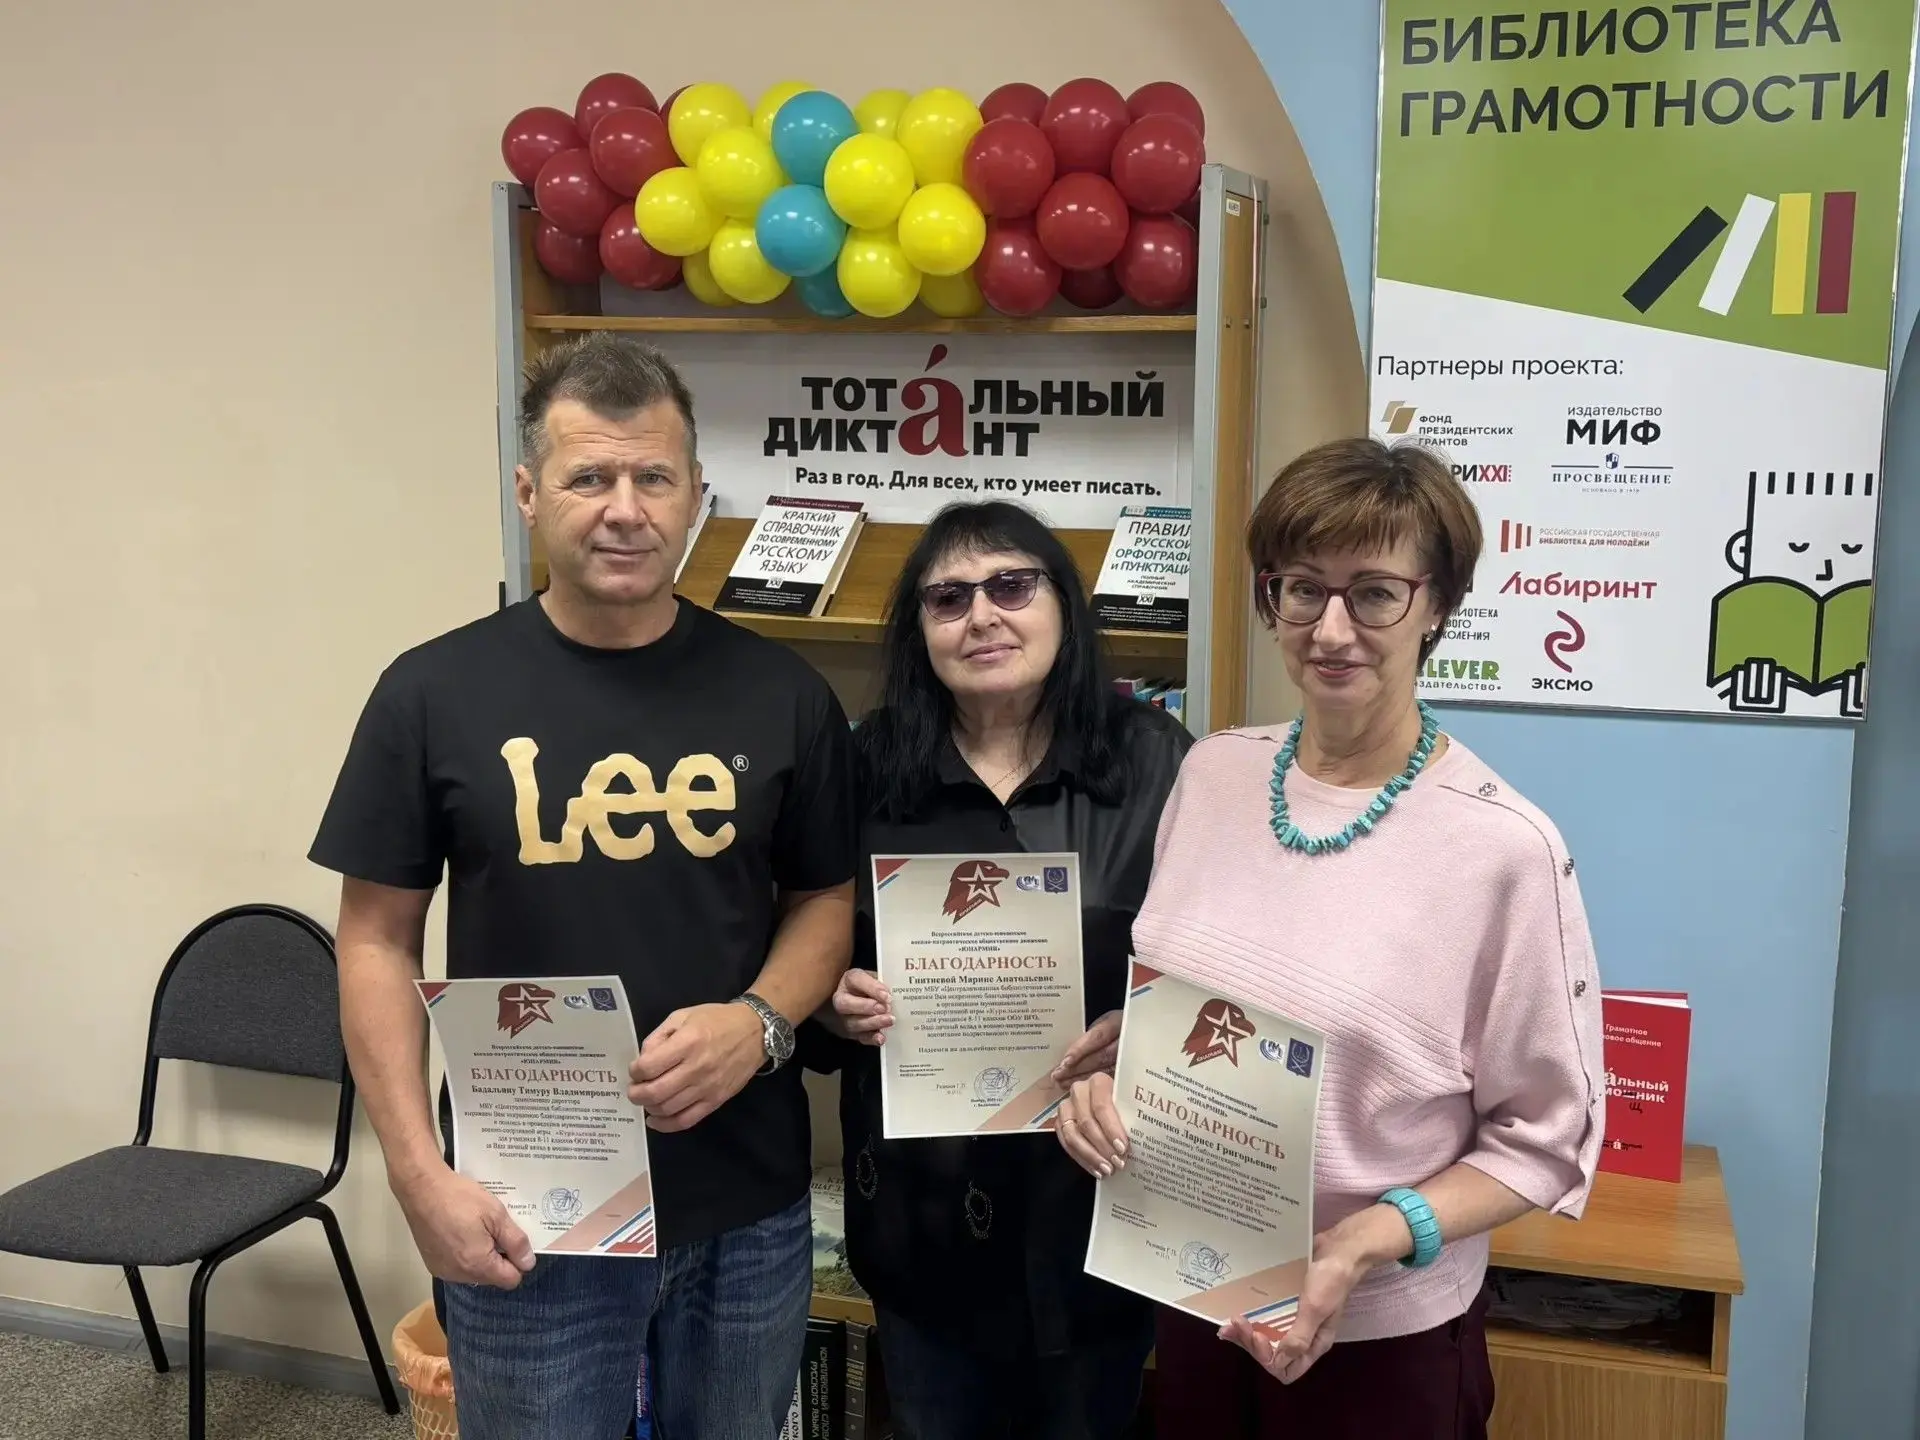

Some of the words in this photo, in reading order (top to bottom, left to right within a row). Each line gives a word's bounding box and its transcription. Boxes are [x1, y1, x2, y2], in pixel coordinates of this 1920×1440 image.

[1402, 0, 1842, 65] БИБЛИОТЕКА
[1400, 70, 1889, 137] ГРАМОТНОСТИ
[1377, 356, 1503, 380] Партнеры
[1512, 358, 1624, 380] проекта:
[1419, 415, 1452, 424] ФОНД
[1567, 406, 1662, 417] издательство
[1418, 427, 1513, 436] ПРЕЗИДЕНТСКИХ
[1566, 419, 1661, 446] МИФ
[1418, 438, 1468, 447] ГРАНТОВ
[796, 466, 828, 485] Раз
[832, 473, 843, 485] в
[847, 473, 885, 489] год.
[889, 471, 928, 489] Для
[933, 475, 979, 492] всех,
[984, 477, 1018, 492] кто
[1023, 477, 1081, 496] умеет
[1086, 479, 1161, 497] писать.
[1552, 473, 1672, 484] ПРОСВЕЩЕНИЕ
[782, 510, 837, 523] КРАТКИЙ
[762, 520, 844, 537] СПРАВОЧНИК
[756, 534, 769, 542] ПО
[770, 534, 838, 548] СОВРЕМЕННОМУ
[1539, 537, 1587, 545] БИБЛИОТЕКА
[750, 544, 833, 562] РУССКОМУ
[759, 559, 808, 574] ЯЗЫКУ
[1499, 570, 1657, 603] Лабиринт
[1418, 659, 1500, 680] LEVER
[1531, 677, 1593, 691] ЭКСМО
[501, 737, 736, 865] Lee
[904, 956, 1057, 972] БЛАГОДАРНОСТЬ
[1605, 1023, 1648, 1036] Грамотное
[1602, 1034, 1624, 1042] овое
[1625, 1036, 1662, 1047] общение
[471, 1067, 618, 1083] БЛАГОДАРНОСТЬ
[1133, 1085, 1287, 1160] БЛАГОДАРНОСТЬ
[810, 1360, 818, 1405] РУССКОГО
